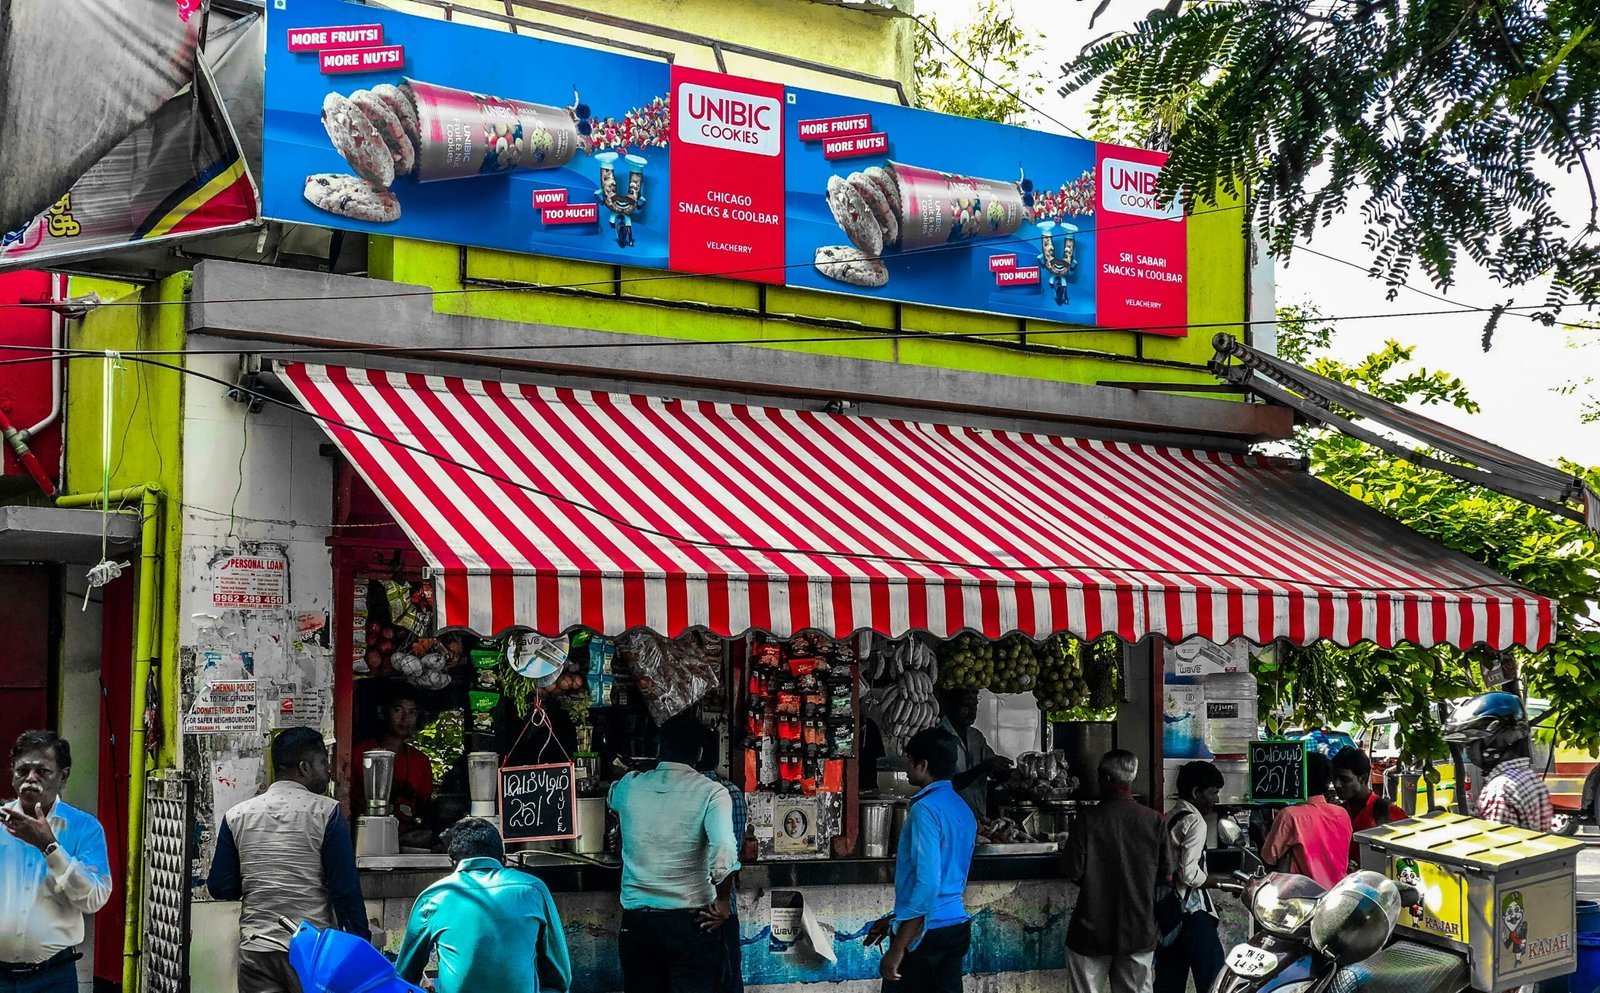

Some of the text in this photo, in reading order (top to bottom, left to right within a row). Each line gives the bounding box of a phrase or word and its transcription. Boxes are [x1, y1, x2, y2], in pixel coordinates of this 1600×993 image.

[291, 29, 378, 46] MORE FRUITS!
[324, 50, 399, 67] MORE NUTS!
[688, 93, 771, 131] UNIBIC
[801, 118, 867, 135] MORE FRUITS!
[701, 124, 759, 145] COOKIES
[463, 125, 472, 162] UNIBIC
[826, 137, 885, 154] MORE NUTS!
[1109, 166, 1158, 196] UNIB
[535, 193, 564, 203] WOW!
[707, 190, 752, 206] CHICAGO
[545, 208, 594, 219] TOO MUCH!
[679, 202, 779, 225] SNACKS & COOLBAR
[706, 241, 752, 254] VELACHERRY
[991, 257, 1014, 267] WOW!
[1119, 253, 1167, 267] SRI SABARI
[999, 270, 1038, 281] TOO MUCH!
[1103, 264, 1183, 283] SNACKS N COOLBAR
[1125, 299, 1162, 309] VELACHERRY
[230, 558, 284, 570] PERSONAL LOAN
[214, 594, 283, 604] 9962 299 450
[1179, 664, 1203, 674] wave
[212, 683, 255, 692] CHENNAI POLICE
[210, 695, 217, 703] TO
[196, 706, 246, 715] DONATE THIRD EYE
[197, 716, 213, 724] SAFER
[213, 716, 255, 724] NEIGHBOURHOOD
[773, 926, 800, 936] wave
[1425, 917, 1459, 934] KAJAH
[1528, 933, 1569, 959] KAJAH
[1245, 949, 1265, 962] TN 19
